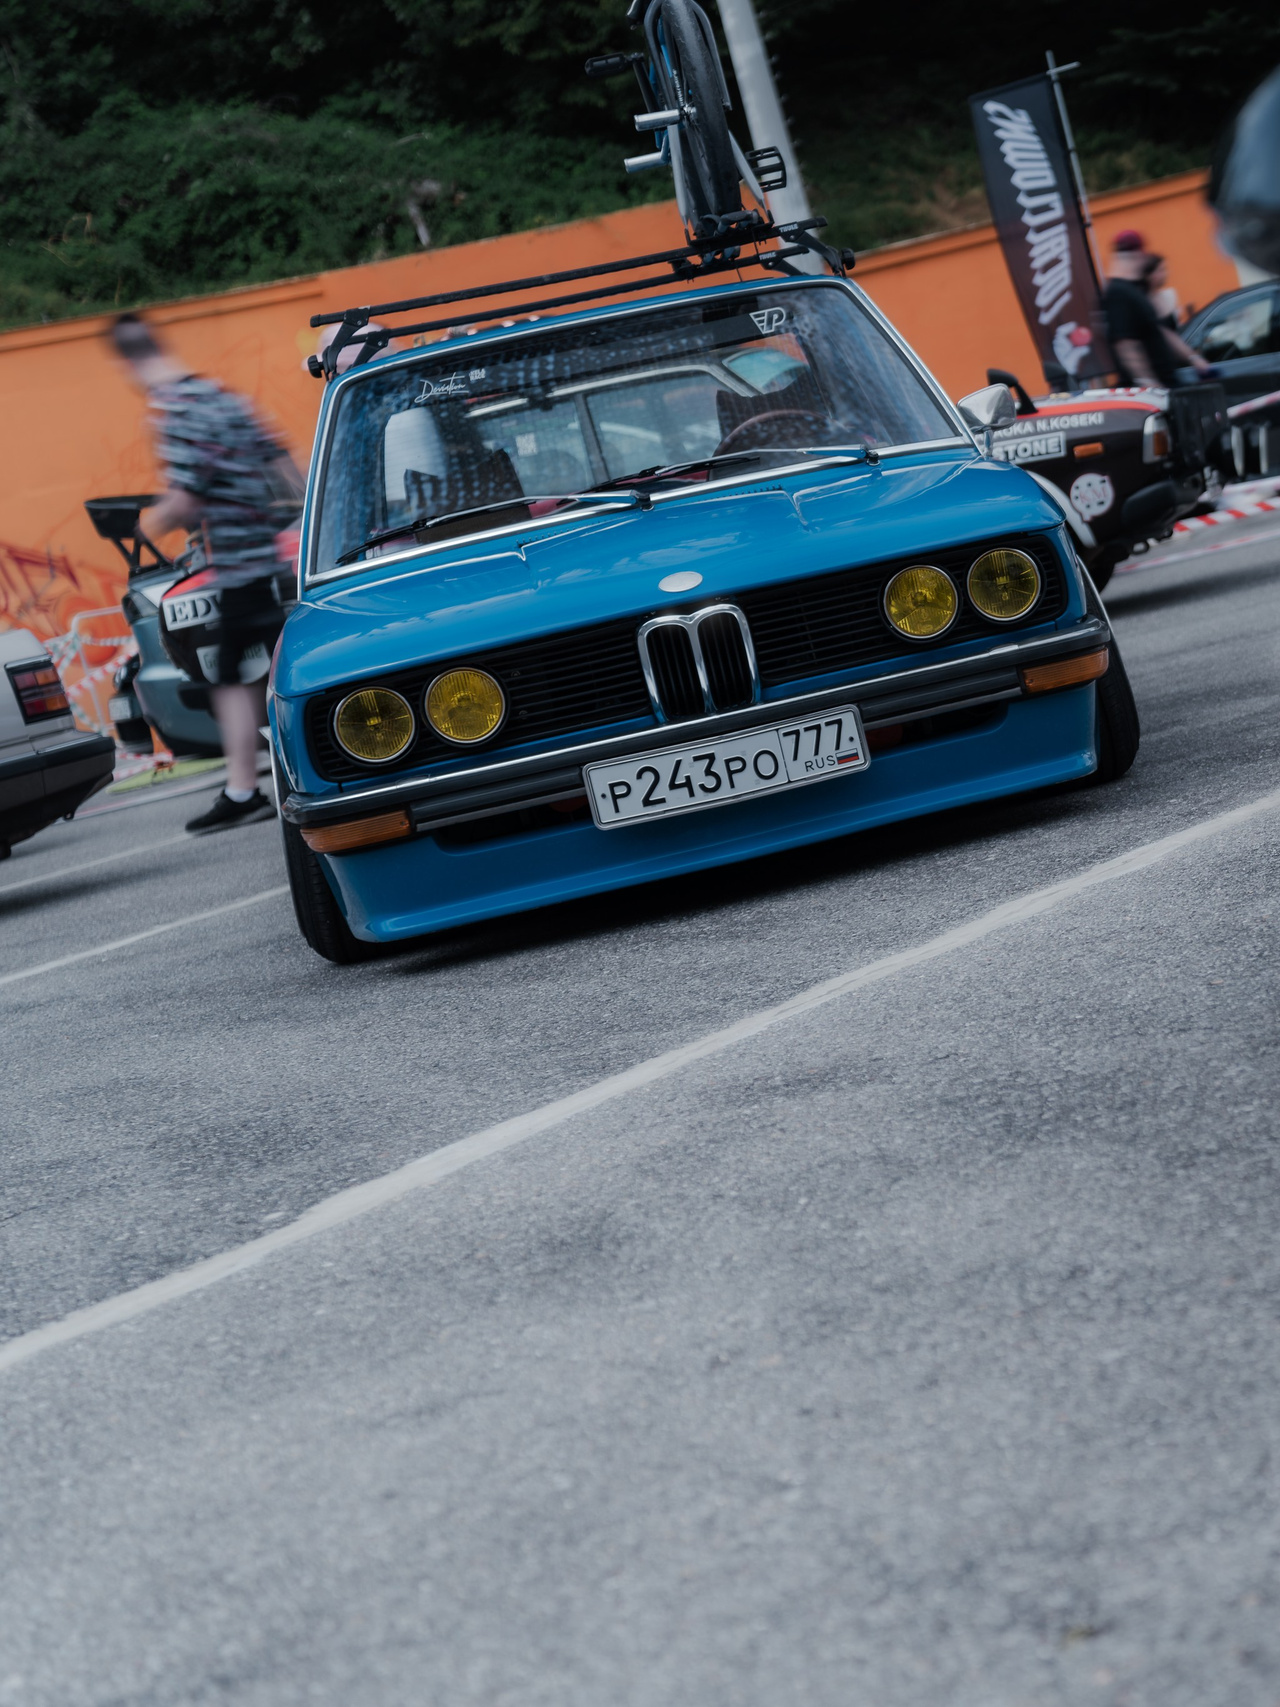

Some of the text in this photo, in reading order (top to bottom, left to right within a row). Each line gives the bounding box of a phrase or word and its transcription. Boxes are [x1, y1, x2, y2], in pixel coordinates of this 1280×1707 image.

[992, 437, 1060, 461] STONE
[608, 718, 842, 813] P243PO 777
[804, 754, 836, 772] RUS
